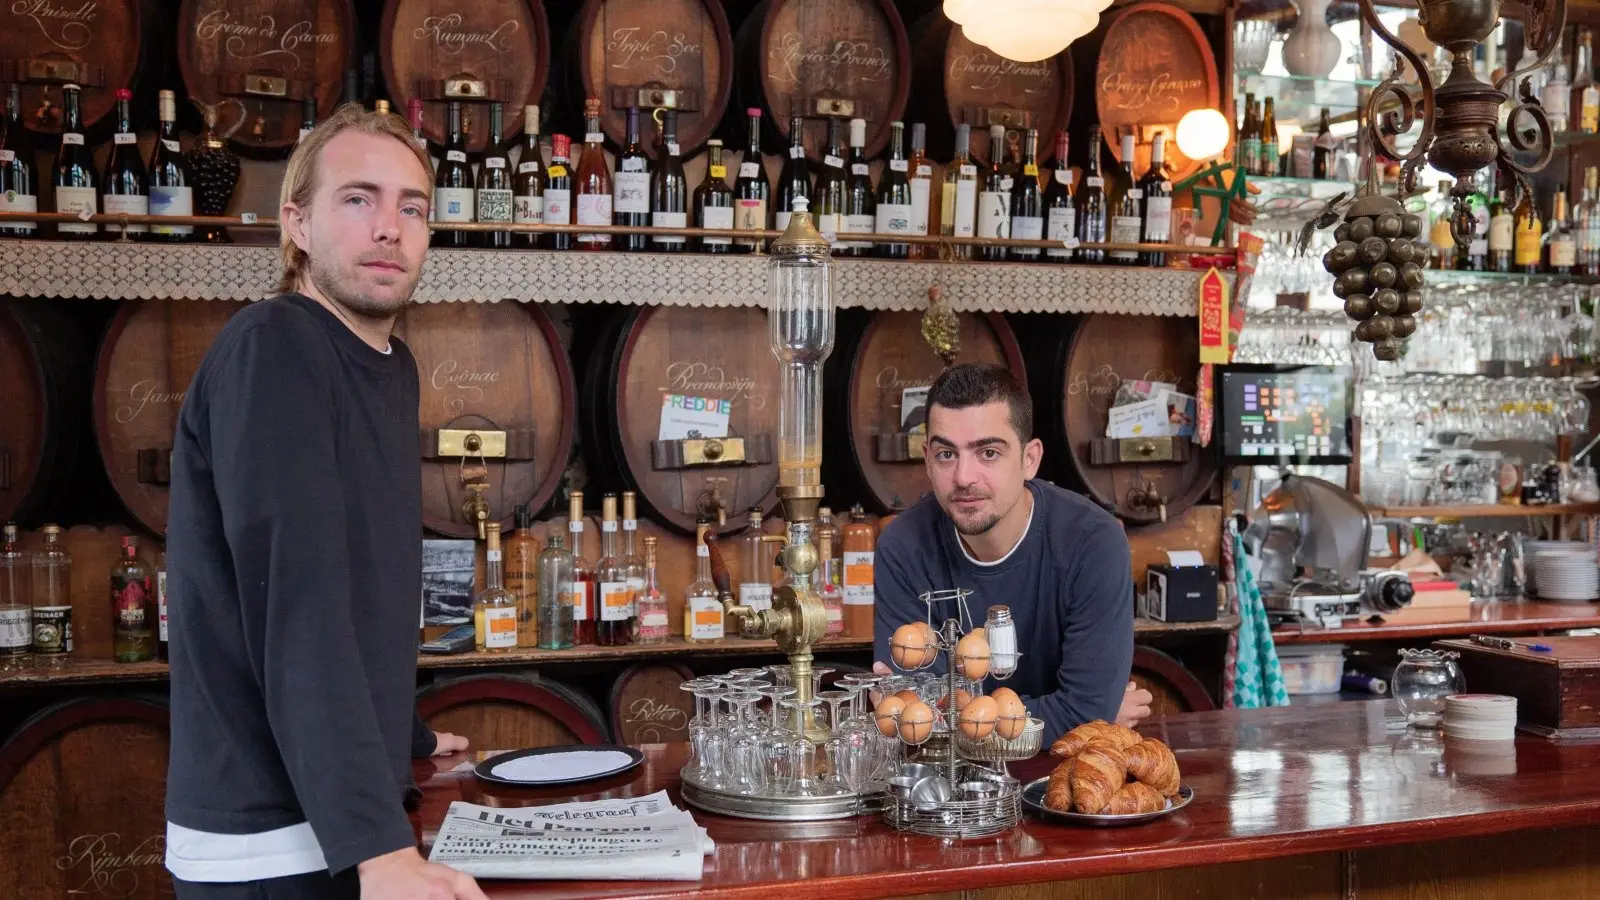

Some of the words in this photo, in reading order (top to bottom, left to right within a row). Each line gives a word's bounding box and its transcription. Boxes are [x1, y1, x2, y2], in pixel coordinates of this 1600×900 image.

[281, 21, 339, 51] Cacao
[608, 27, 668, 67] Triple
[950, 53, 1001, 87] Cherry
[626, 697, 688, 730] Bitter
